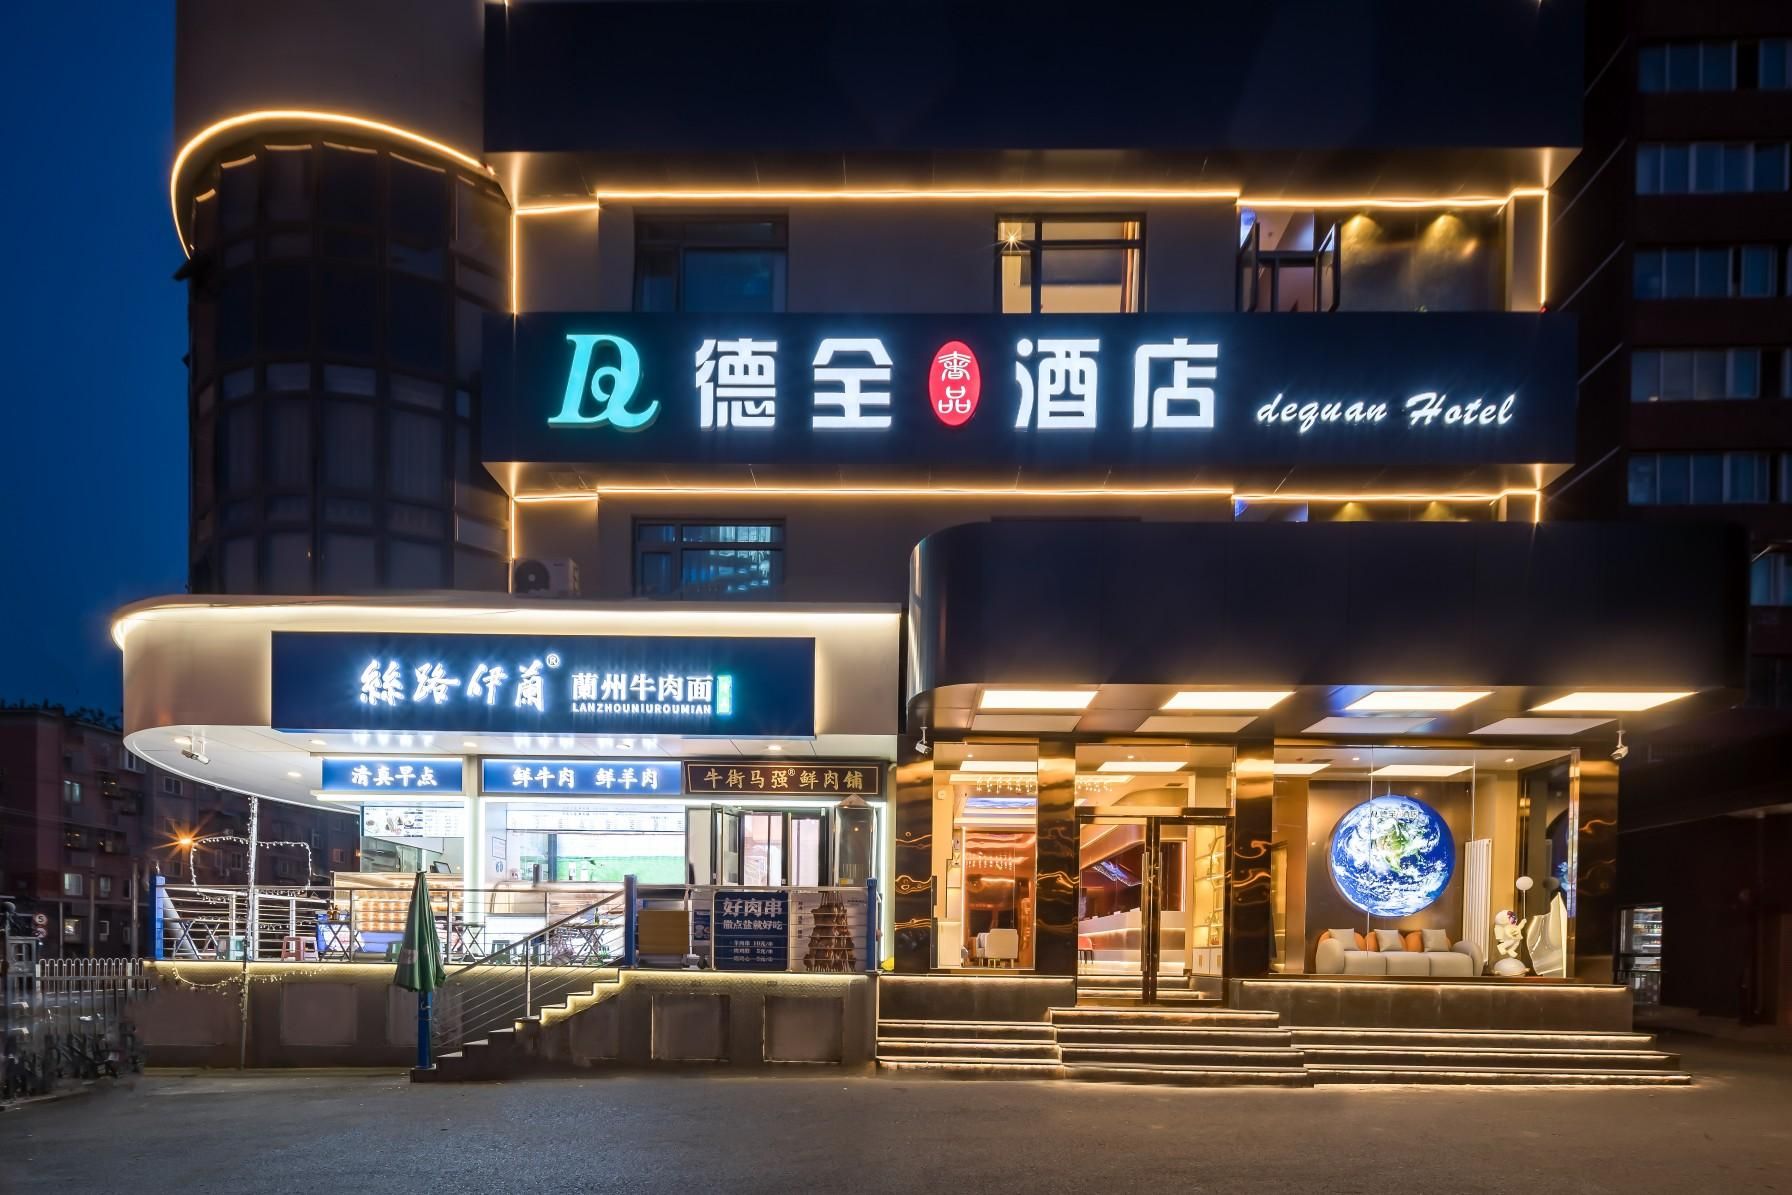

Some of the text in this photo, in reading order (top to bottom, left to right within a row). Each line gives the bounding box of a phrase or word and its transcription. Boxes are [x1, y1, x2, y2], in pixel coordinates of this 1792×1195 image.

[1256, 391, 1517, 434] dequan Hotel
[571, 673, 713, 702] 蘭州牛肉面
[572, 703, 712, 713] LANZHOUNIUROUMIAN
[351, 764, 438, 787] 清真早点
[512, 766, 659, 790] 鲜牛肉 鲜羊肉
[723, 897, 783, 917] 好肉串
[38, 915, 44, 923] 5
